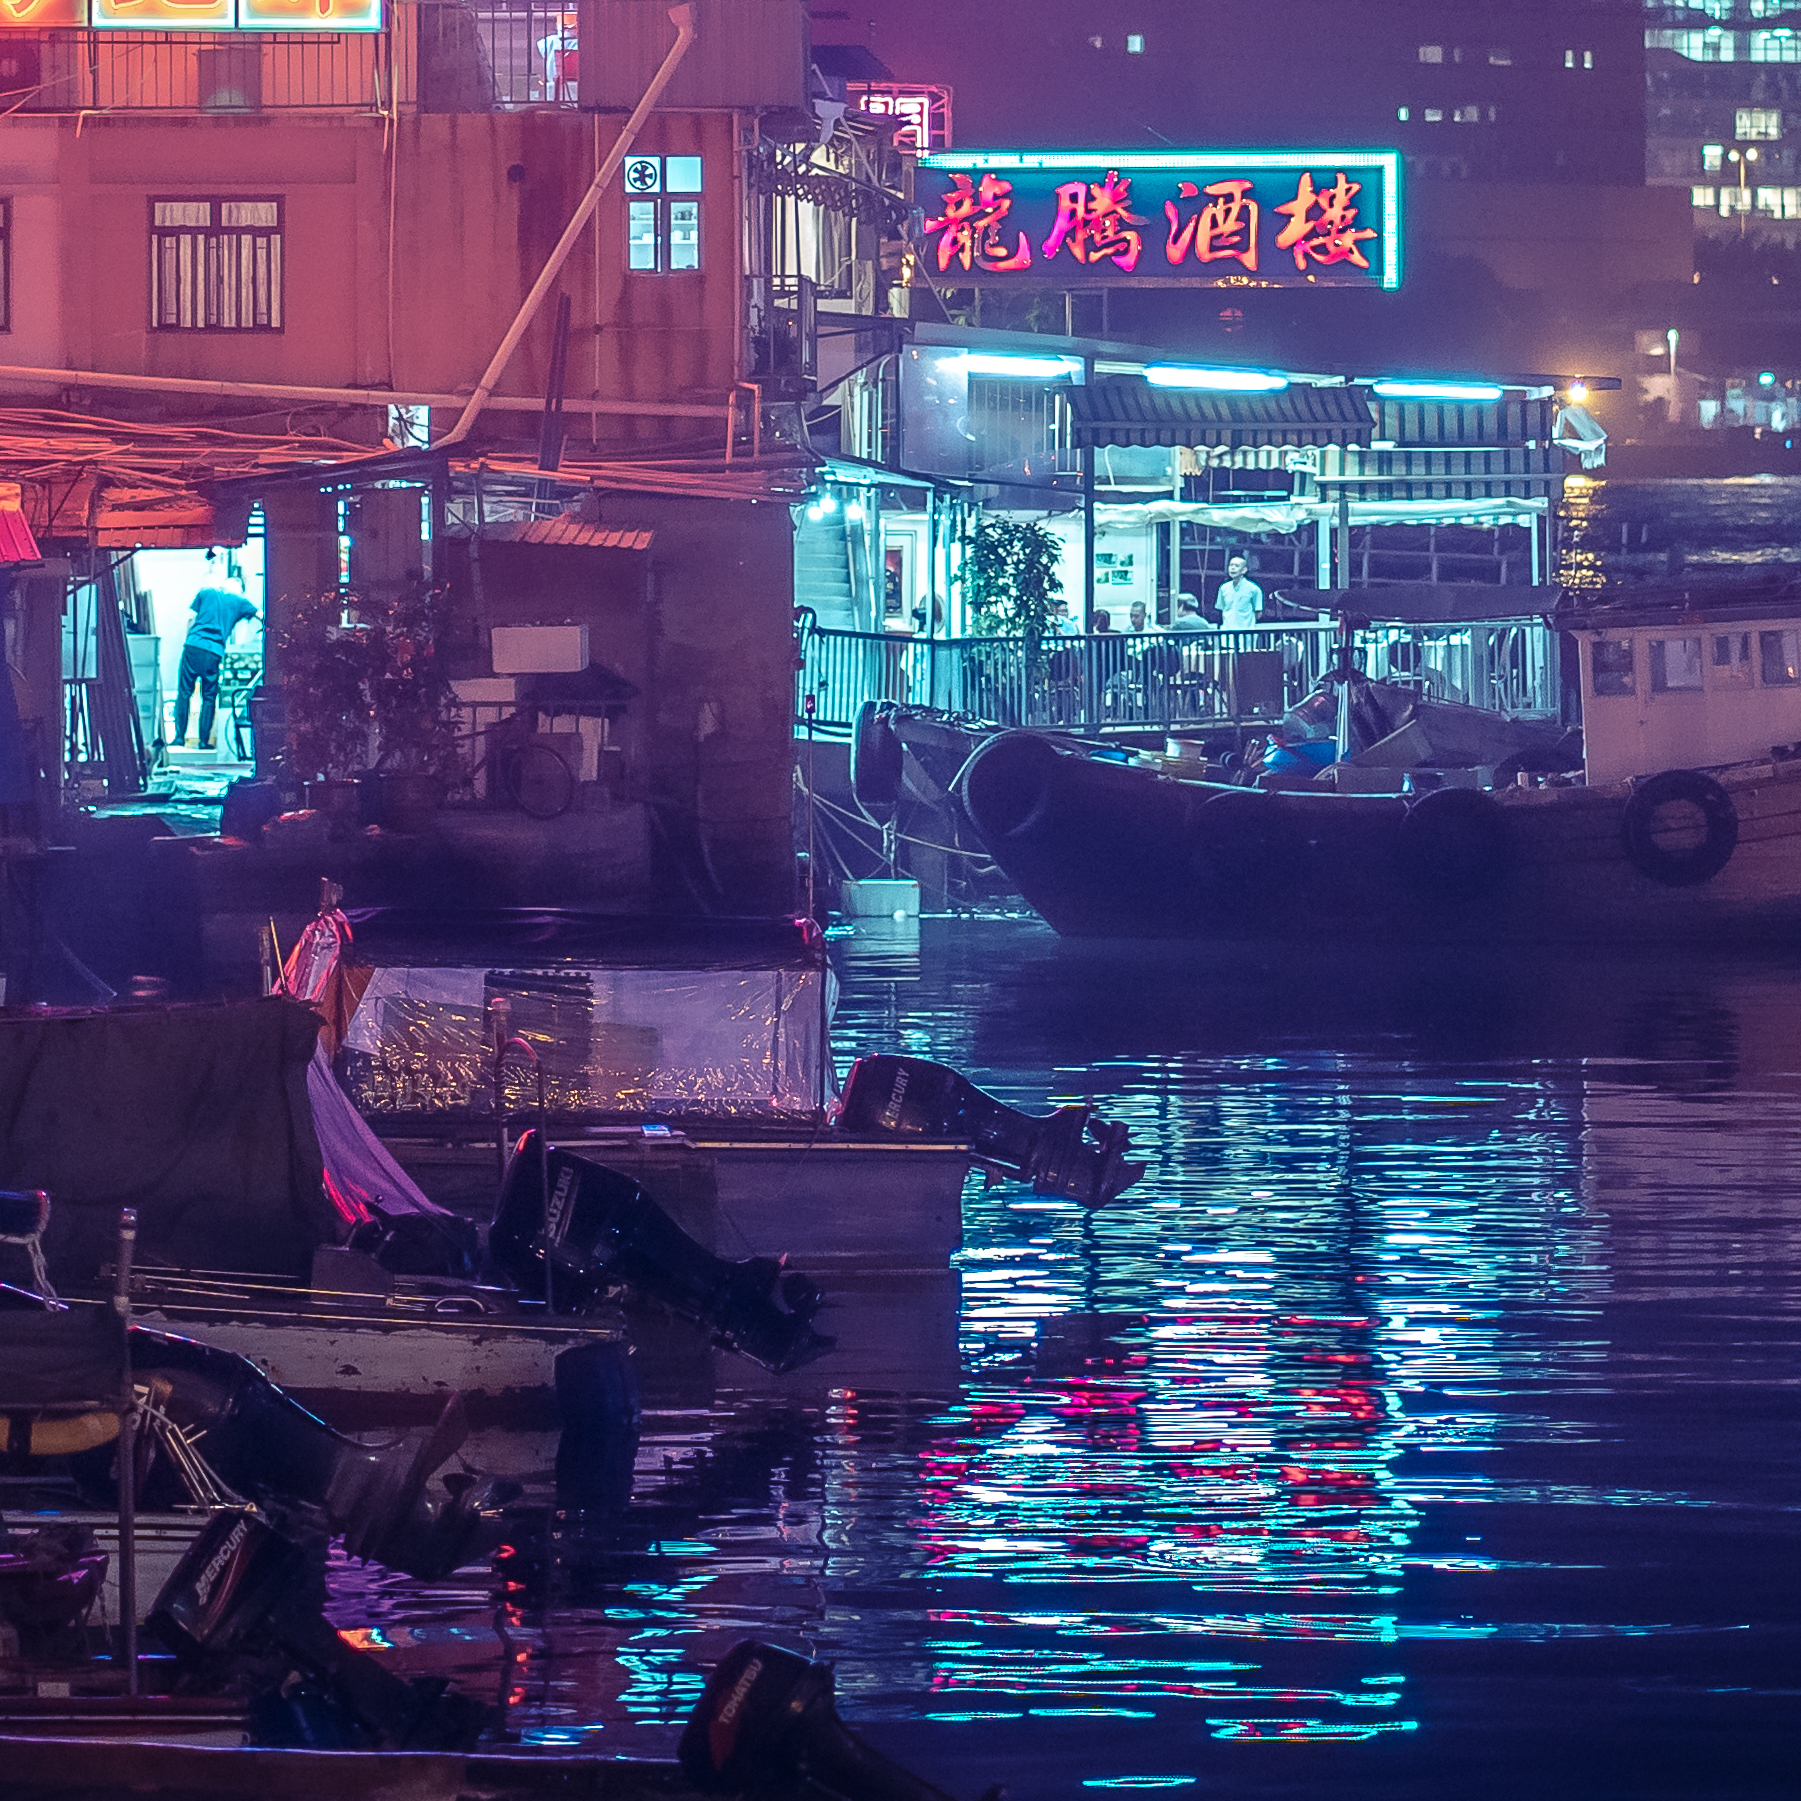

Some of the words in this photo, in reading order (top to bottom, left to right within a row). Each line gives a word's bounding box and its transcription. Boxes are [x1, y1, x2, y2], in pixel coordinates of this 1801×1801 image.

[923, 169, 1377, 273] 龍騰酒樓
[878, 1067, 910, 1131] MERCURY
[540, 1166, 574, 1240] SUZUKI
[195, 1519, 248, 1606] MERCURY
[718, 1658, 763, 1724] TOHATSU
